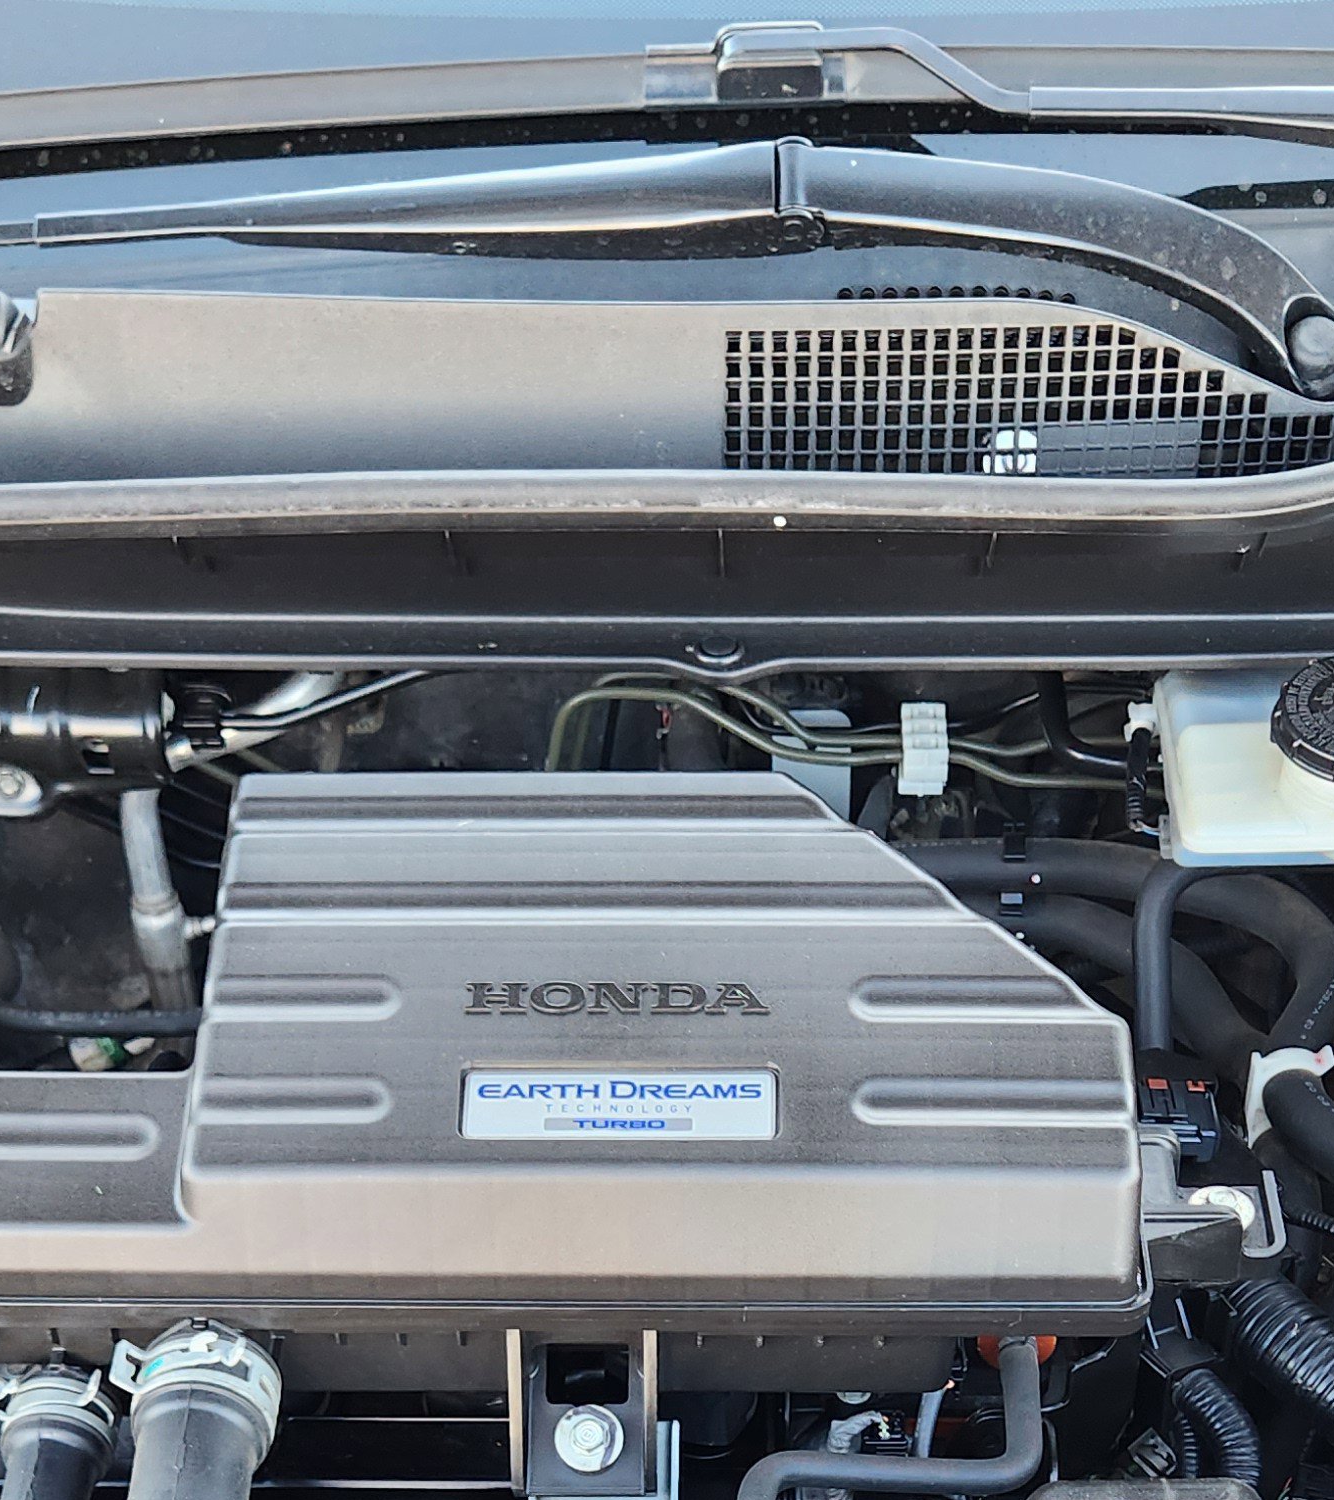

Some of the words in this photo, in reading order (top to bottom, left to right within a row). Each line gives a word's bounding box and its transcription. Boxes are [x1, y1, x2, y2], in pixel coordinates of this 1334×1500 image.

[464, 981, 771, 1015] HONDA
[477, 1083, 600, 1099] EARTH
[608, 1079, 762, 1100] DREAMS
[545, 1104, 693, 1114] TECHNOLOGY
[573, 1119, 665, 1130] TURBO
